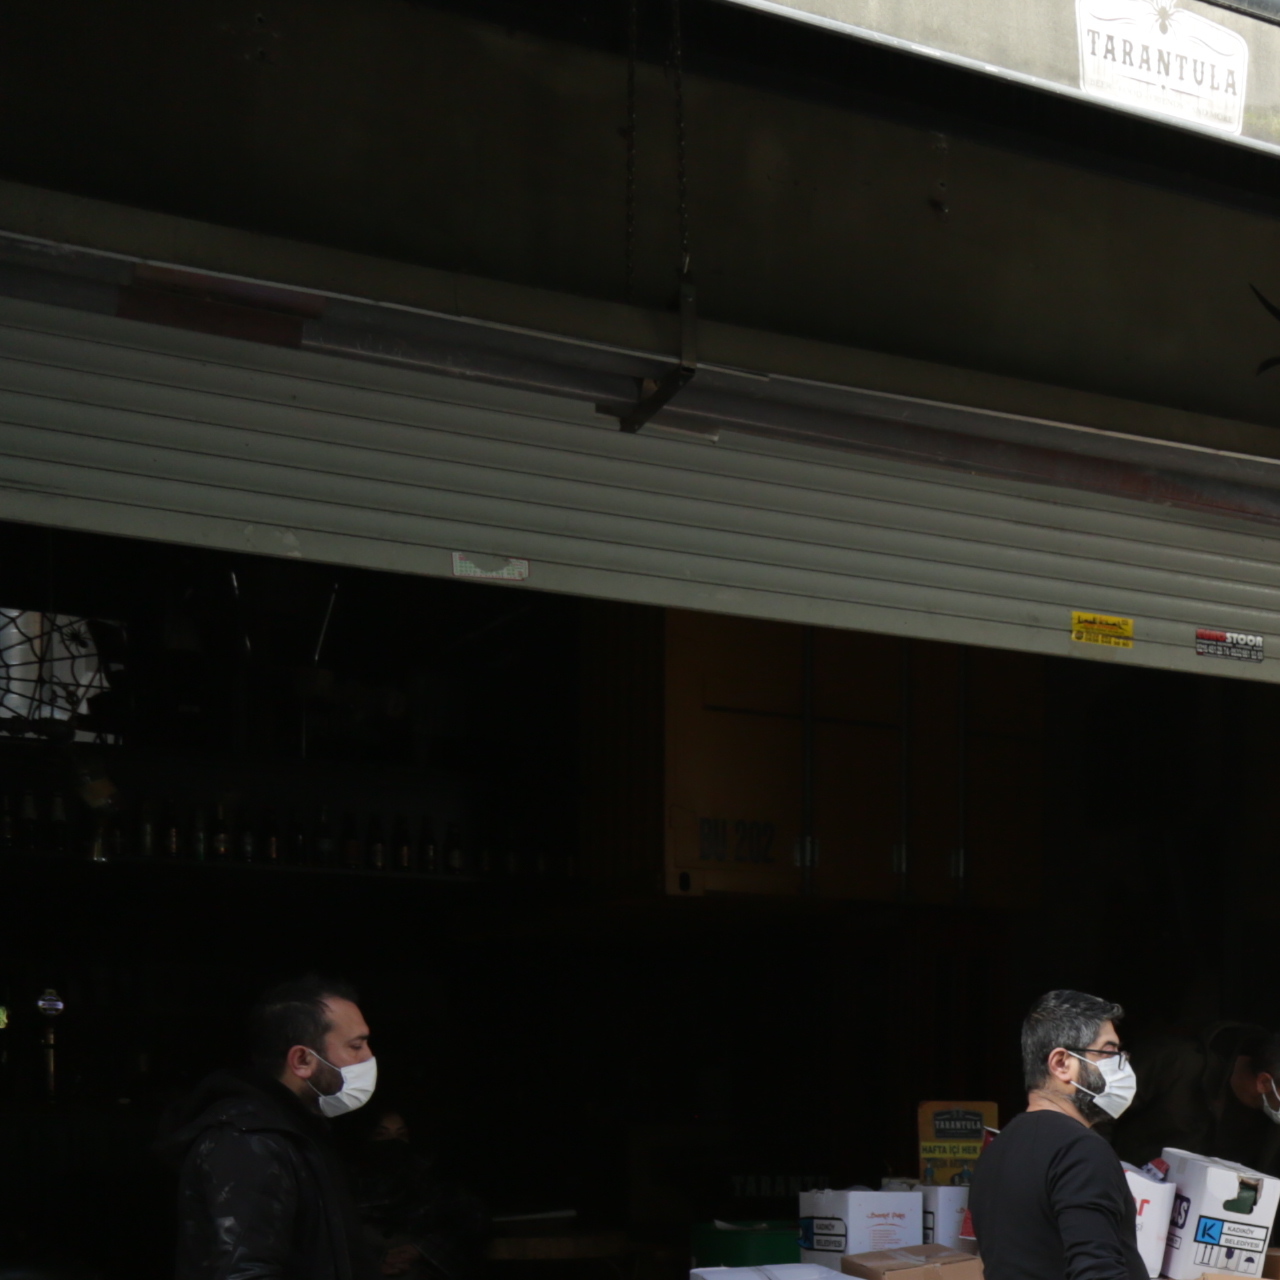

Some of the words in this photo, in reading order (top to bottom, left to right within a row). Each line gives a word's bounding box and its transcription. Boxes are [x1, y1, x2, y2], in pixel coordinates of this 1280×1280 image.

[1087, 28, 1237, 96] TARANTULA
[935, 1120, 981, 1130] TARANTULA
[922, 1145, 948, 1154] HAFTA
[961, 1145, 978, 1154] HER
[1227, 1225, 1255, 1235] KADIKÖY
[1225, 1237, 1260, 1249] BELEDİYESİ
